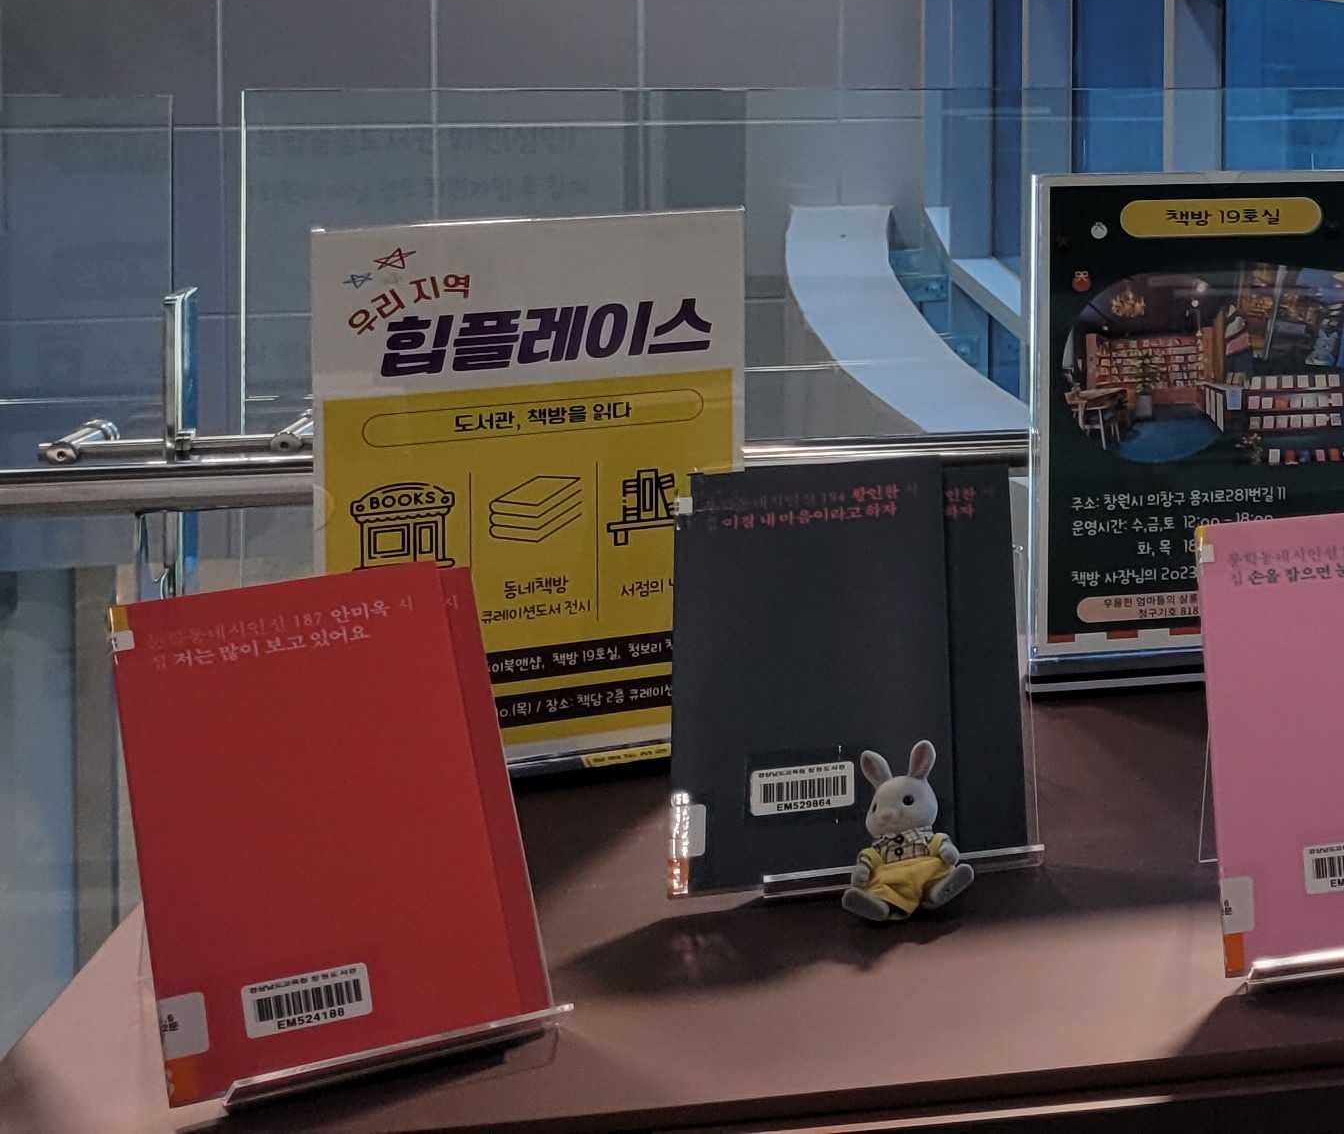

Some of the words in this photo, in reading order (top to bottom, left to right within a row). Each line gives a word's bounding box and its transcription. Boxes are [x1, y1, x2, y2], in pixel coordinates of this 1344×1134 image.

[1165, 208, 1210, 227] 책방
[1219, 208, 1281, 226] 19호실
[348, 288, 405, 336] 우리
[409, 274, 470, 304] 지역
[380, 298, 712, 378] 힙플레이스
[454, 412, 521, 433] 도서관,
[528, 406, 587, 426] 책방을
[593, 401, 632, 421] 읽다
[369, 491, 436, 510] BOOKS
[1071, 494, 1100, 512] 주소:
[1103, 493, 1143, 511] 창원시
[1146, 490, 1186, 508] 의창구
[1190, 487, 1274, 506] 용지로281번길
[1277, 486, 1286, 501] 11
[779, 507, 863, 526] 마음이라고
[865, 501, 897, 518] 하자
[1071, 518, 1128, 537] 운영시간:
[1131, 516, 1176, 535] 수,금,토
[1159, 540, 1172, 556] 목
[1071, 570, 1100, 588] 책방
[1104, 568, 1157, 587] 사장님의
[1249, 569, 1280, 585] 손을
[1285, 564, 1331, 583] 잡으면
[503, 575, 569, 599] 동네책방
[621, 579, 664, 597] 서점의
[482, 603, 561, 623] 큐레이션도서
[564, 600, 591, 615] 전시
[1136, 595, 1176, 608] 엄마들의
[1181, 606, 1199, 616] 818
[292, 611, 323, 629] 187
[331, 601, 390, 624] 안미옥
[175, 647, 214, 667] 저는
[219, 640, 259, 661] 많이
[264, 635, 306, 654] 보고
[310, 625, 370, 649] 있어요
[488, 656, 545, 673] 이북앤샵,
[552, 652, 579, 666] 책방
[628, 641, 662, 657] 청보리
[546, 697, 573, 713] 장소:
[577, 694, 602, 707] 책담
[606, 689, 624, 704] 2층
[777, 798, 832, 812] EM529864
[277, 1007, 346, 1031] EM524188
